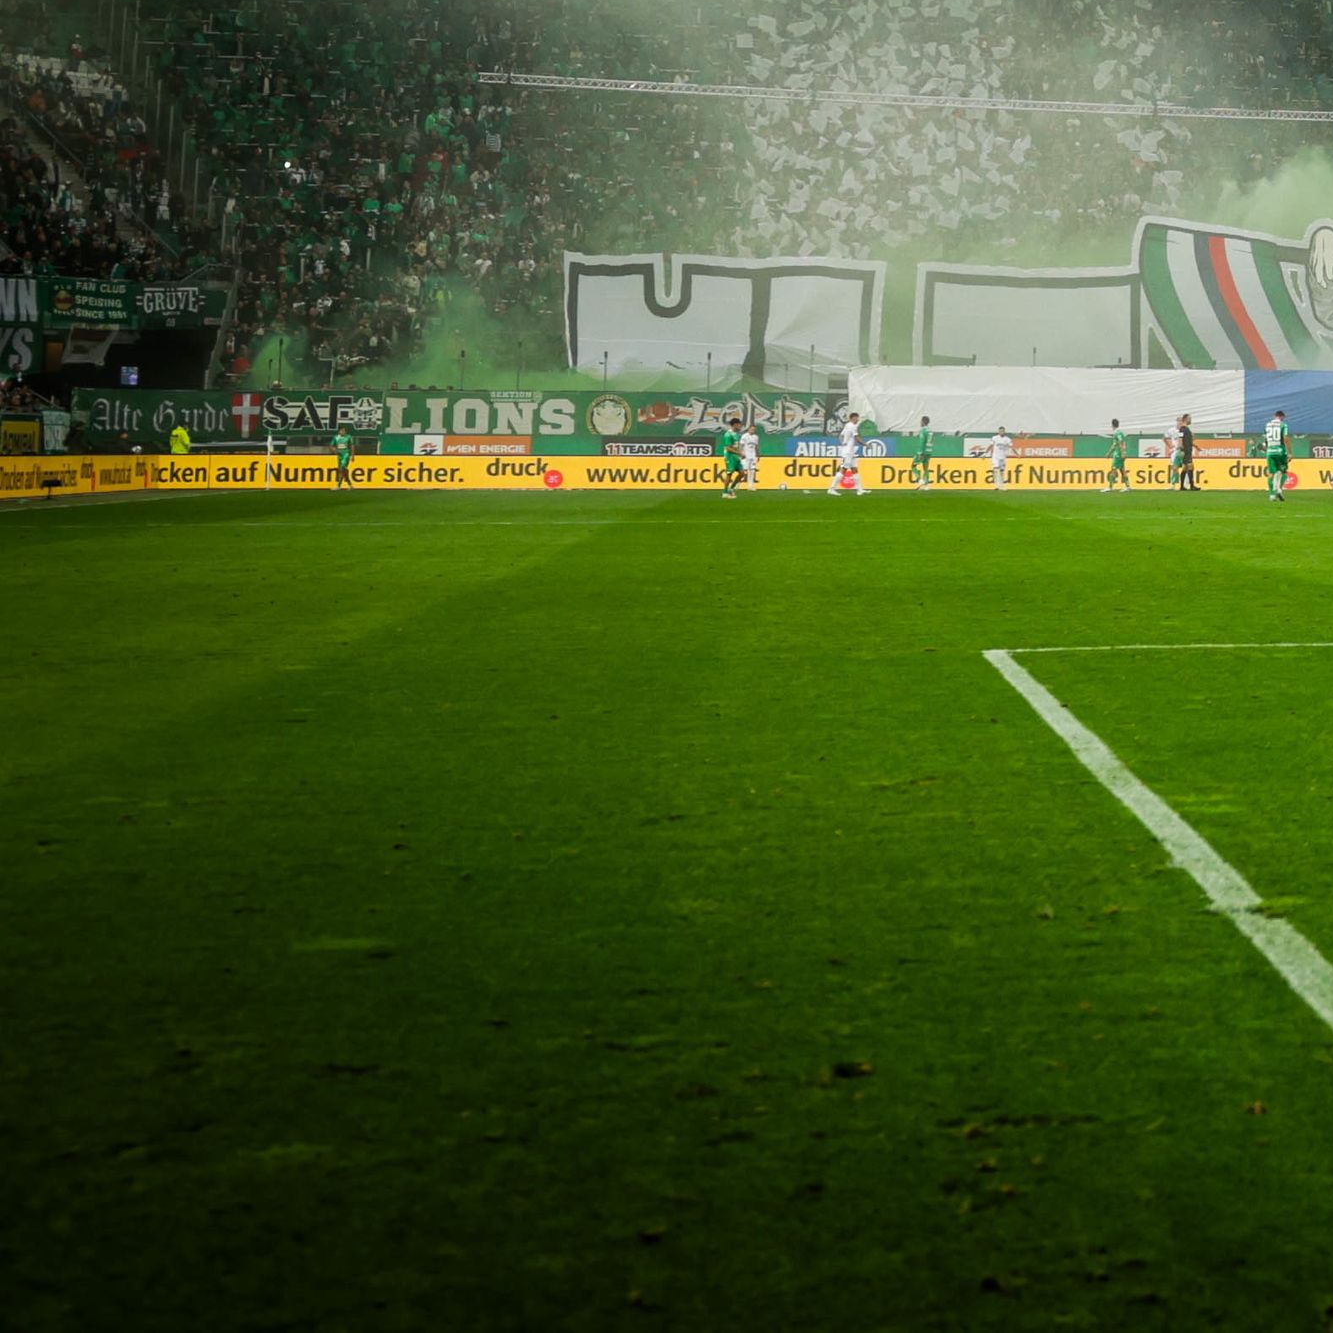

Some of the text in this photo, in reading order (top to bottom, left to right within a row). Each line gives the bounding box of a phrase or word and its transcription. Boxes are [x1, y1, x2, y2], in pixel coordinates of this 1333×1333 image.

[385, 397, 576, 435] LIONS
[1266, 426, 1282, 442] 20
[447, 444, 526, 454] WIEN ENERGIE
[1026, 448, 1068, 456] ENERGIE
[216, 462, 259, 482] auf
[384, 462, 464, 483] sicher.
[486, 458, 548, 476] druck
